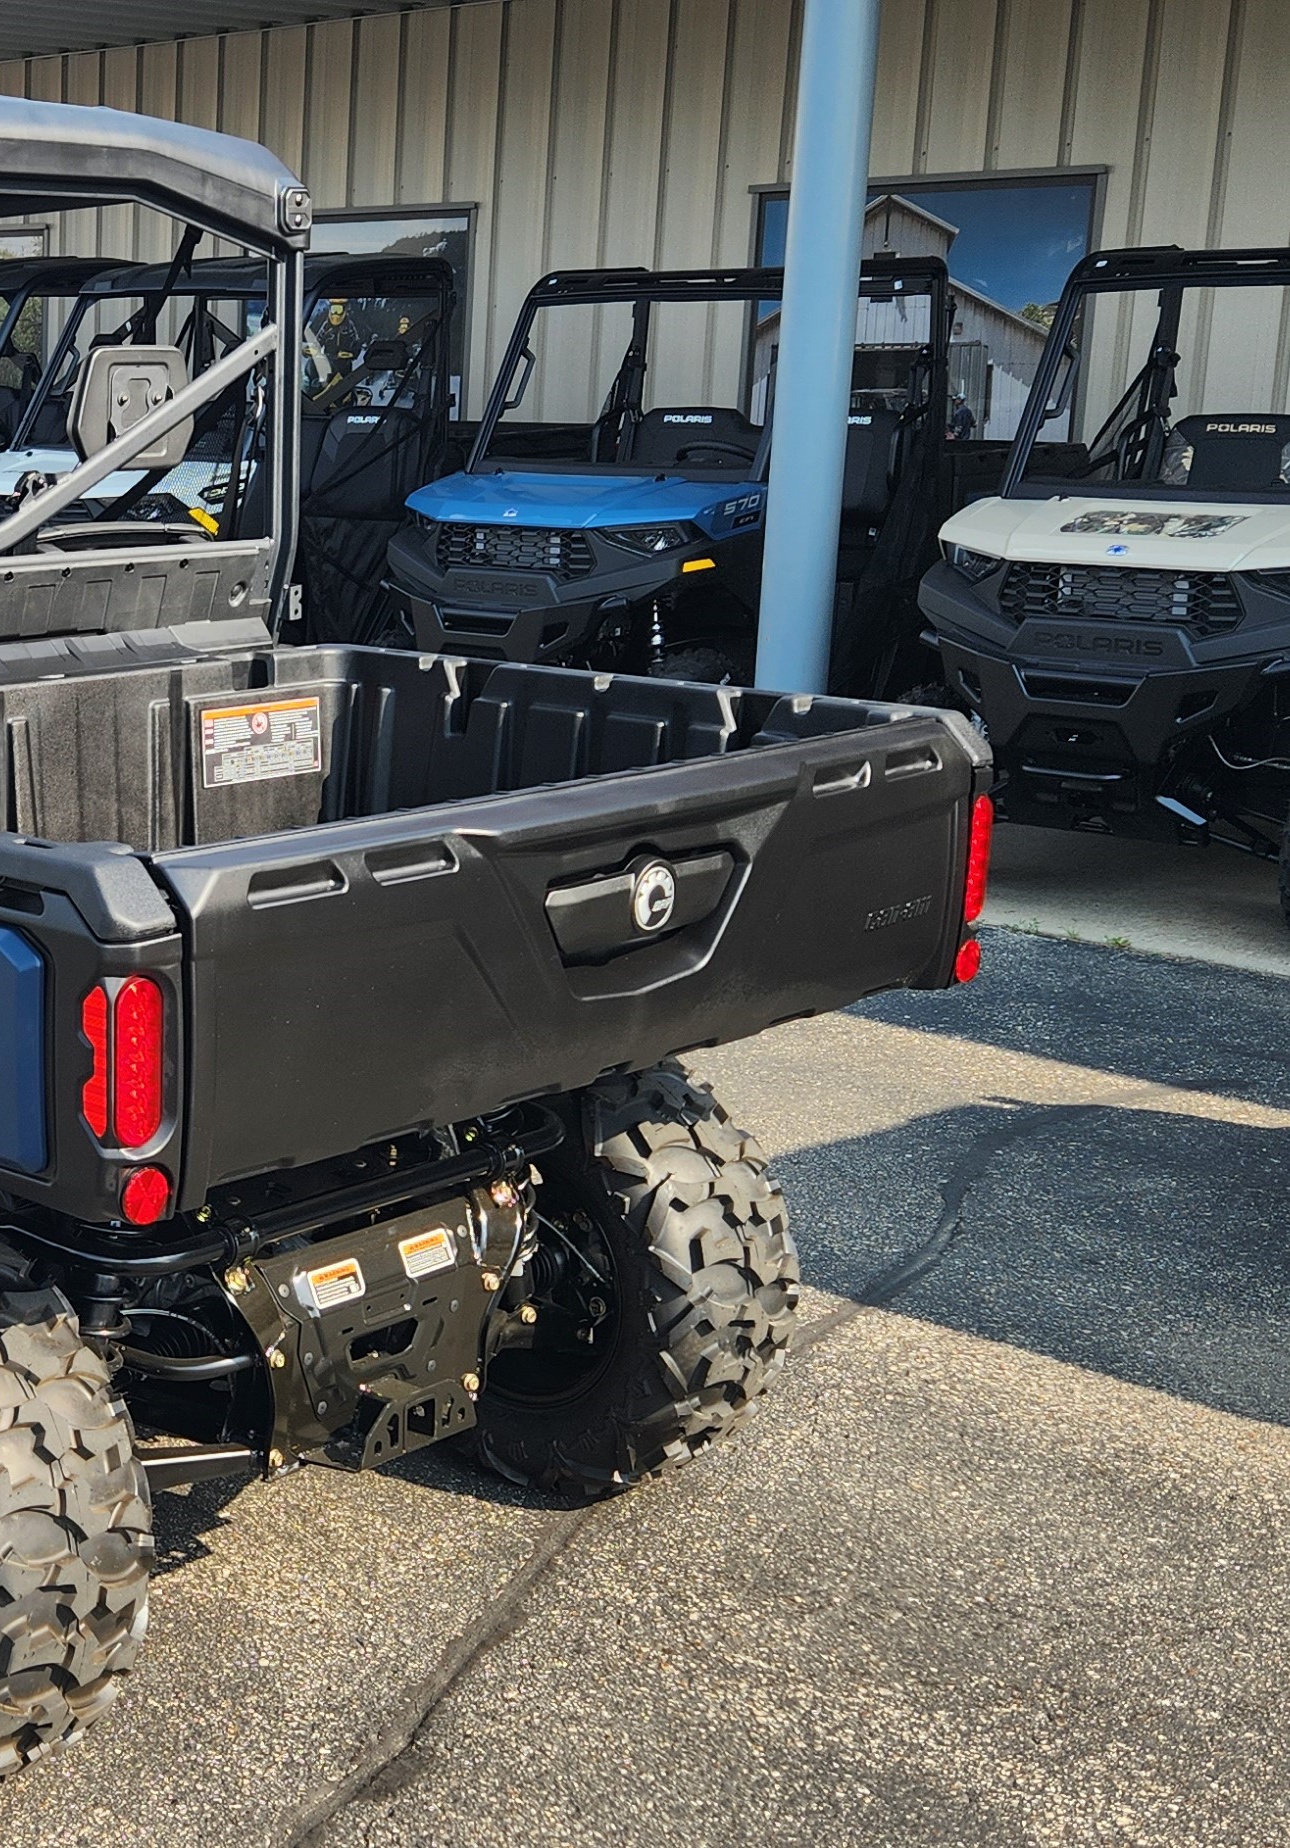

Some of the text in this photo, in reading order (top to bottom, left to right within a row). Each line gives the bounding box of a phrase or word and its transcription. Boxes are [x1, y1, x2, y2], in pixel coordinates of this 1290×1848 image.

[347, 416, 387, 424] POLAR
[663, 414, 713, 424] POLARIS
[1206, 423, 1277, 433] POLARIS
[723, 494, 760, 516] 570
[1034, 631, 1164, 657] POLARIS
